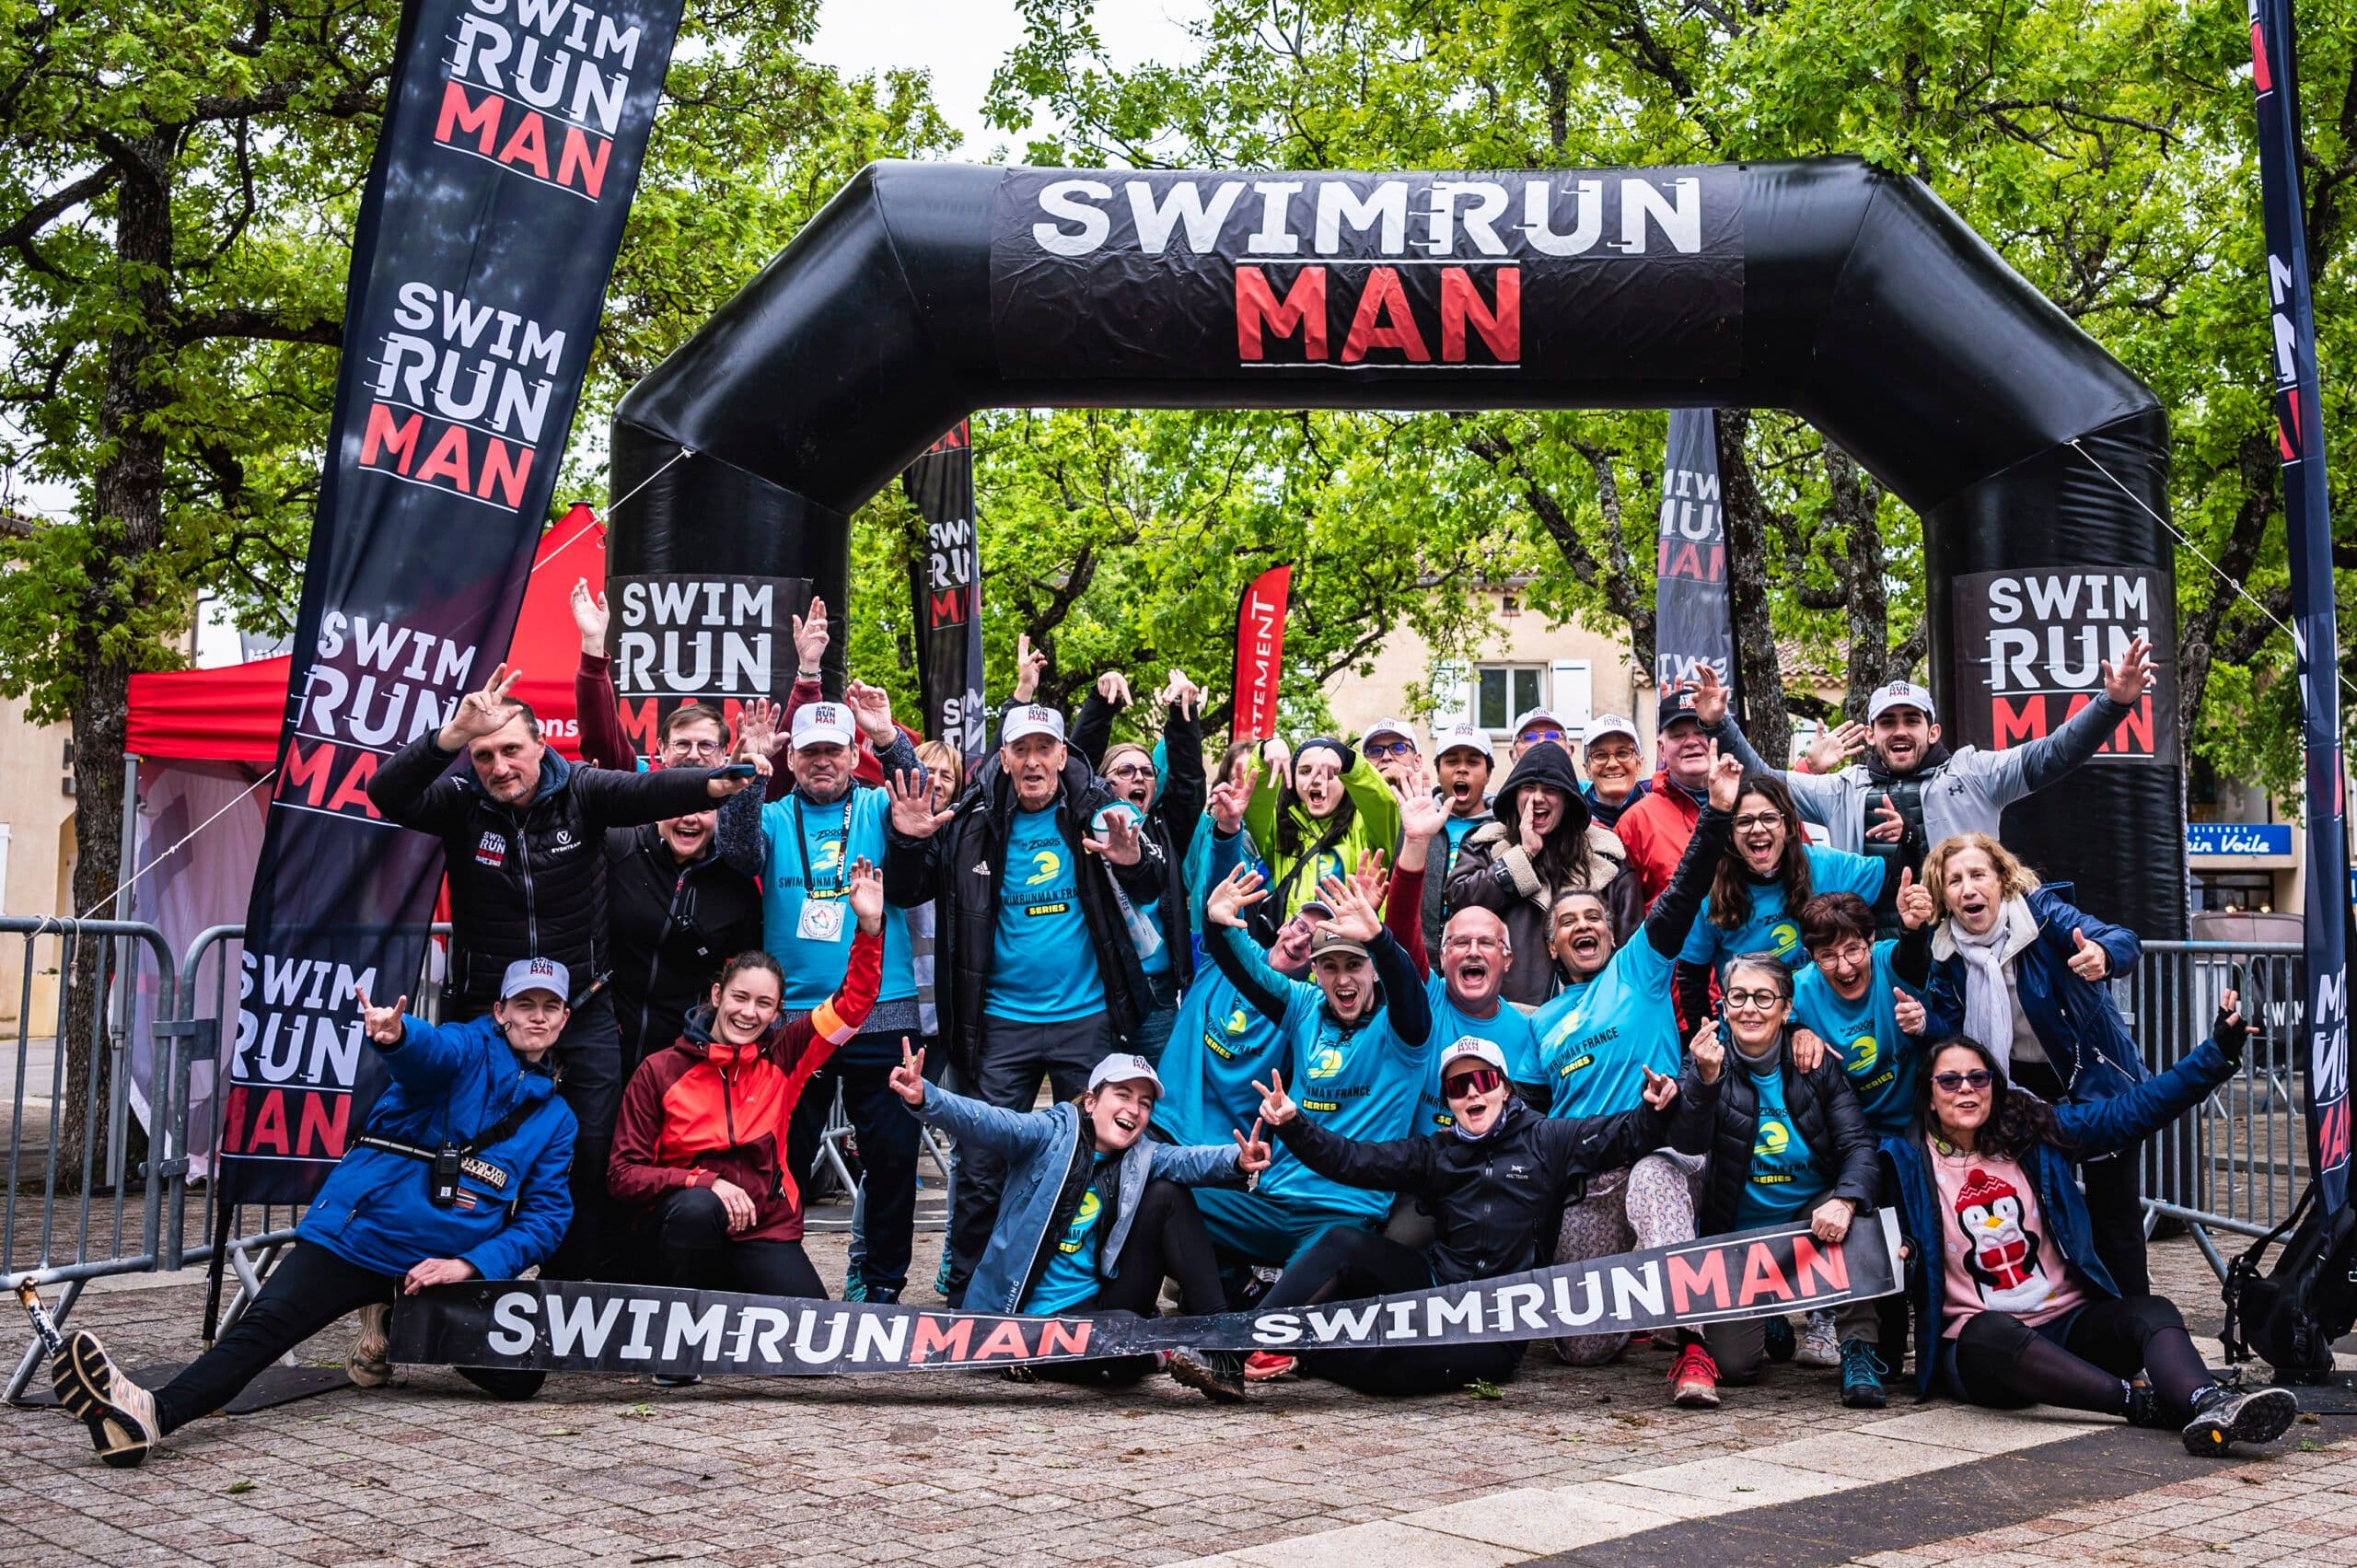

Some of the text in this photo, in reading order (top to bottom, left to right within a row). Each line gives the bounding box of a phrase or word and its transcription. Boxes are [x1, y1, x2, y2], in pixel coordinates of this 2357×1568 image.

[442, 13, 630, 134] RUN
[434, 81, 614, 200] MAN
[1032, 177, 1701, 257] SWIMRUN
[393, 282, 567, 376] SWIM
[1236, 266, 1521, 363] MAN
[364, 331, 553, 444] RUN
[359, 403, 535, 509] MAN
[621, 581, 773, 628] SWIM
[1988, 575, 2149, 624] SWIM
[318, 610, 477, 691] SWIM
[614, 630, 772, 692] RUN
[1980, 625, 2152, 691] RUN
[287, 663, 459, 747] RUN
[816, 710, 836, 718] RUN
[1028, 709, 1049, 717] RUN
[1028, 714, 1049, 723] MAN
[274, 736, 383, 820] MA
[479, 838, 506, 854] RUN
[2220, 834, 2270, 853] Voile
[1028, 903, 1065, 915] SERIES
[240, 949, 377, 1015] SWIM
[530, 968, 553, 977] MAN
[1582, 1027, 1620, 1051] FRANCE
[1303, 1098, 1338, 1111] SERIES
[1335, 1085, 1371, 1099] FRANCE
[1753, 1174, 1792, 1184] SERIES
